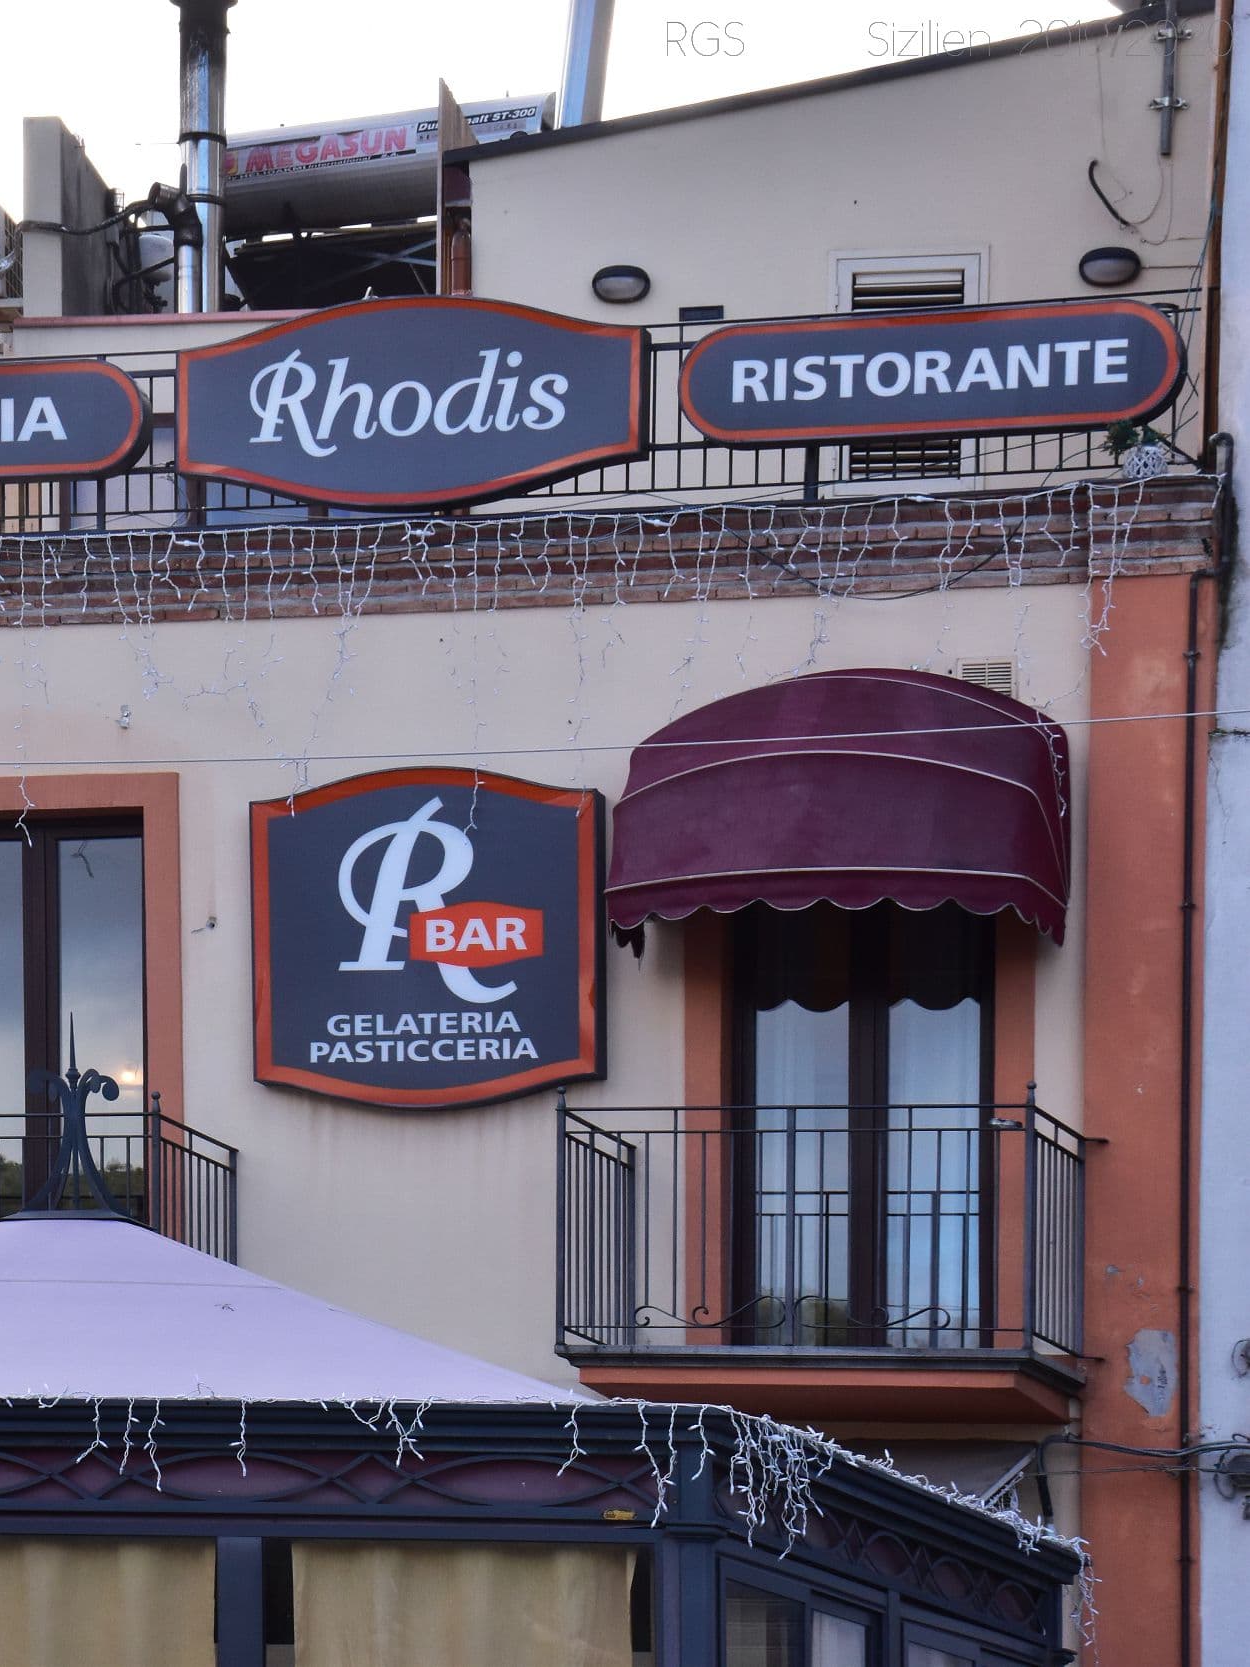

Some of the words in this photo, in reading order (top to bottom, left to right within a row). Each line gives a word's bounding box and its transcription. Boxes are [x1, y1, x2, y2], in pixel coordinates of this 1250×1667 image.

[491, 107, 536, 121] ST-300
[244, 126, 408, 173] MEGASUN
[732, 338, 1129, 403] RISTORANTE
[249, 348, 569, 458] Rhodis
[338, 796, 518, 1004] R
[425, 917, 527, 953] BAR
[326, 1011, 521, 1036] GELATERIA
[310, 1038, 539, 1063] PASTICCERIA
